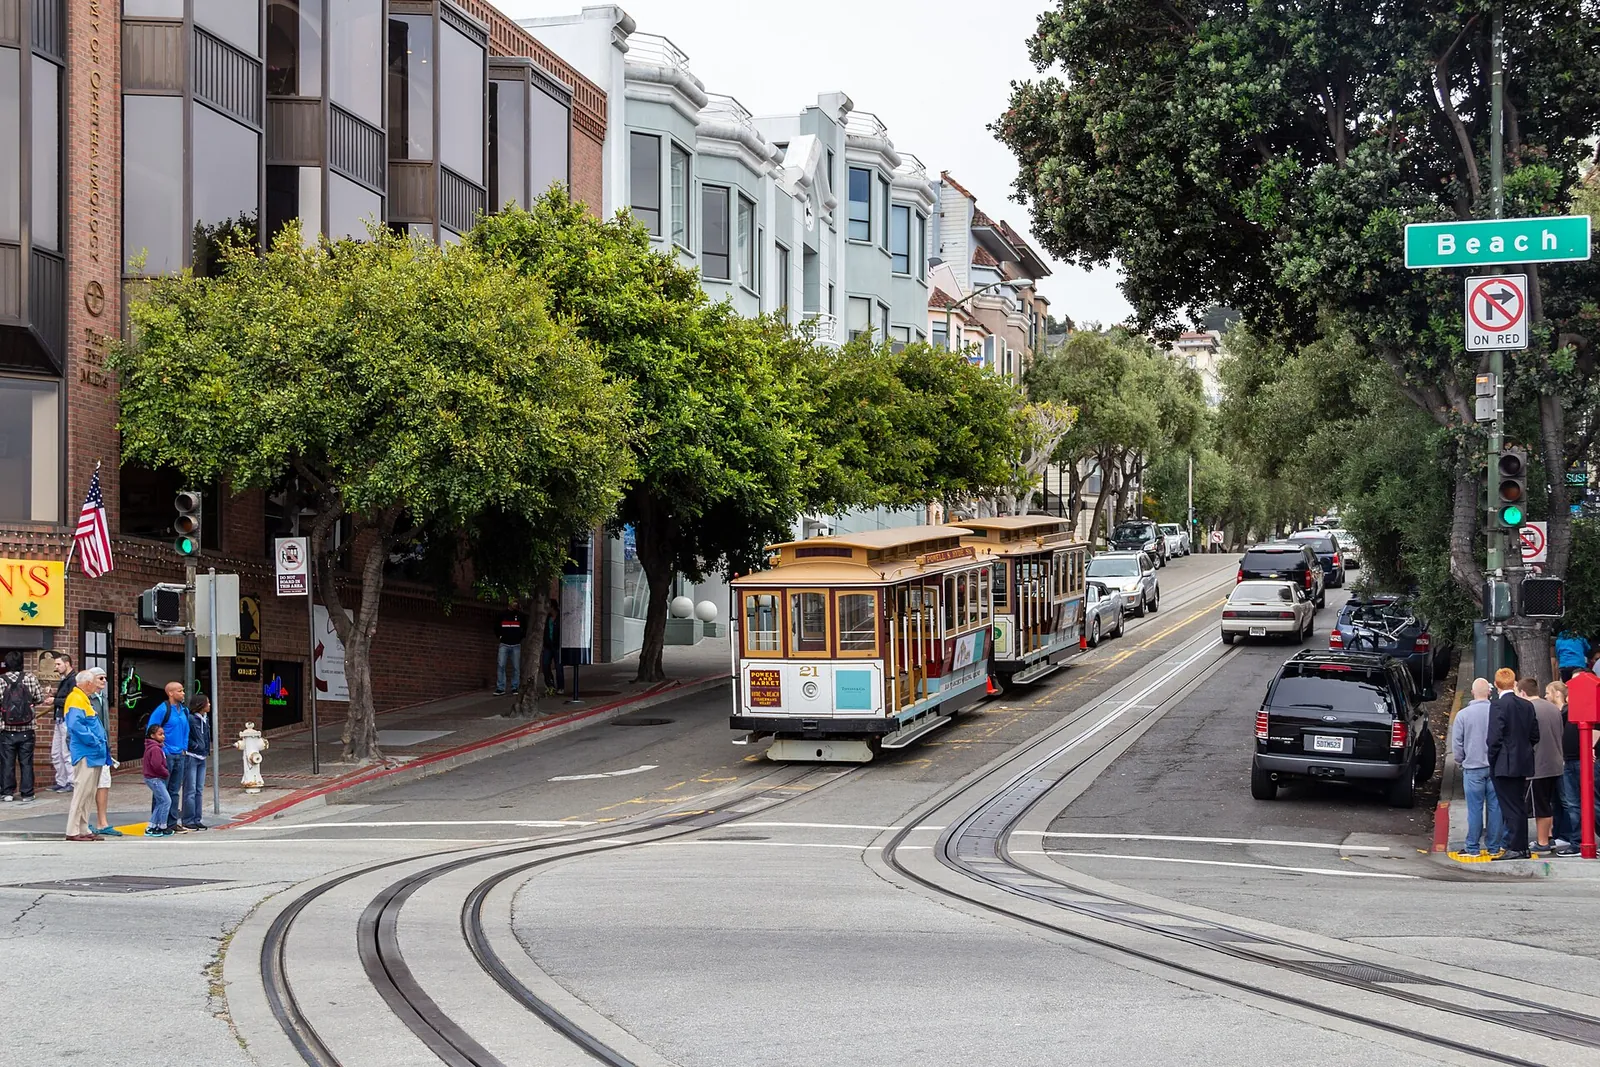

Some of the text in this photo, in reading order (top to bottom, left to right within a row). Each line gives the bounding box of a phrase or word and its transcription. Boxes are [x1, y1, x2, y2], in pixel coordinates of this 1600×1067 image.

[90, 37, 99, 64] OF
[90, 70, 101, 263] OPHTHALMOLOGY
[1437, 229, 1557, 255] Beach
[1474, 334, 1520, 345] ON RED
[926, 553, 946, 563] POWELL
[799, 666, 819, 677] 21
